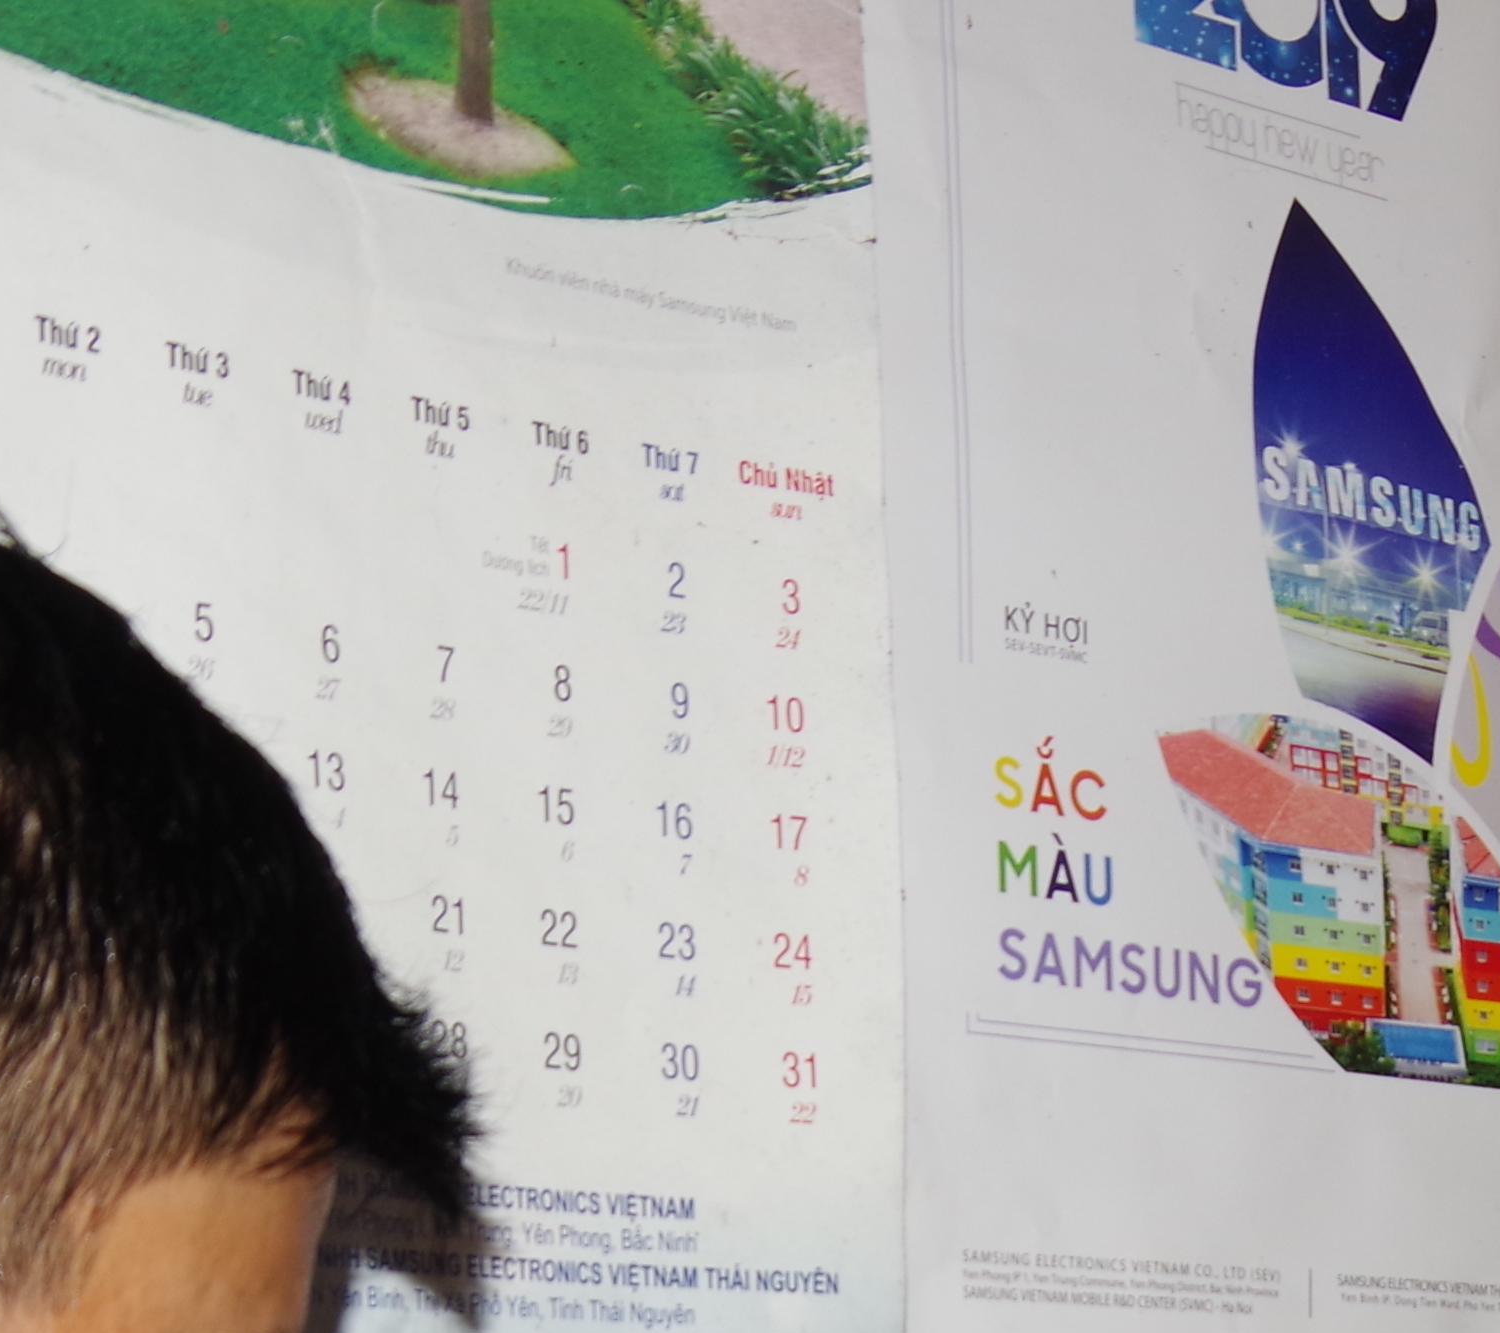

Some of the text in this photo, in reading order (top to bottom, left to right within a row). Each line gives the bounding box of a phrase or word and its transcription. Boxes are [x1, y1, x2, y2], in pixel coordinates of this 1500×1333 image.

[1176, 84, 1384, 186] happy new year
[34, 314, 101, 354] Thứ 2
[42, 357, 87, 382] mon
[165, 340, 230, 379] Thứ 3
[292, 368, 351, 406] Thứ 4
[410, 395, 470, 432] Thứ 5
[425, 431, 455, 459] thu
[531, 420, 589, 455] Thứ 6
[549, 456, 573, 487] fri
[641, 442, 699, 475] Thứ 7
[738, 459, 834, 497] Chủ Nhật
[1261, 444, 1482, 549] SAMSUNG
[557, 543, 569, 580] 1
[668, 561, 686, 600] 2
[782, 578, 801, 616] 3
[195, 601, 214, 643] 5
[1004, 602, 1088, 649] KỶ HỢI
[321, 624, 341, 664] 6
[437, 644, 455, 683] 7
[554, 664, 572, 703] 8
[670, 681, 689, 720] 9
[767, 695, 805, 734] 10
[308, 750, 346, 792] 13
[423, 768, 459, 809] 14
[994, 735, 1107, 822] SẮC
[538, 786, 575, 826] 15
[656, 801, 693, 841] 16
[770, 814, 808, 851] 17
[997, 832, 1112, 906] MÀU
[431, 894, 464, 935] 21
[540, 908, 578, 950] 22
[658, 921, 696, 962] 23
[773, 931, 813, 970] 24
[998, 926, 1263, 1009] SAMSUNG
[432, 1020, 468, 1060] 28
[543, 1031, 582, 1072] 29
[661, 1042, 700, 1082] 30
[782, 1050, 817, 1089] 31
[467, 1182, 600, 1214] ELECTRONICS
[467, 1254, 602, 1285] ELECTRONICS
[704, 1263, 750, 1290] THÁI
[756, 1266, 839, 1294] NGUYÊN
[962, 1249, 1031, 1266] SAMSUNG
[1035, 1254, 1126, 1272] ELECTRONICS
[1131, 1260, 1190, 1276] VIETNAM
[1223, 1266, 1246, 1280] LTD
